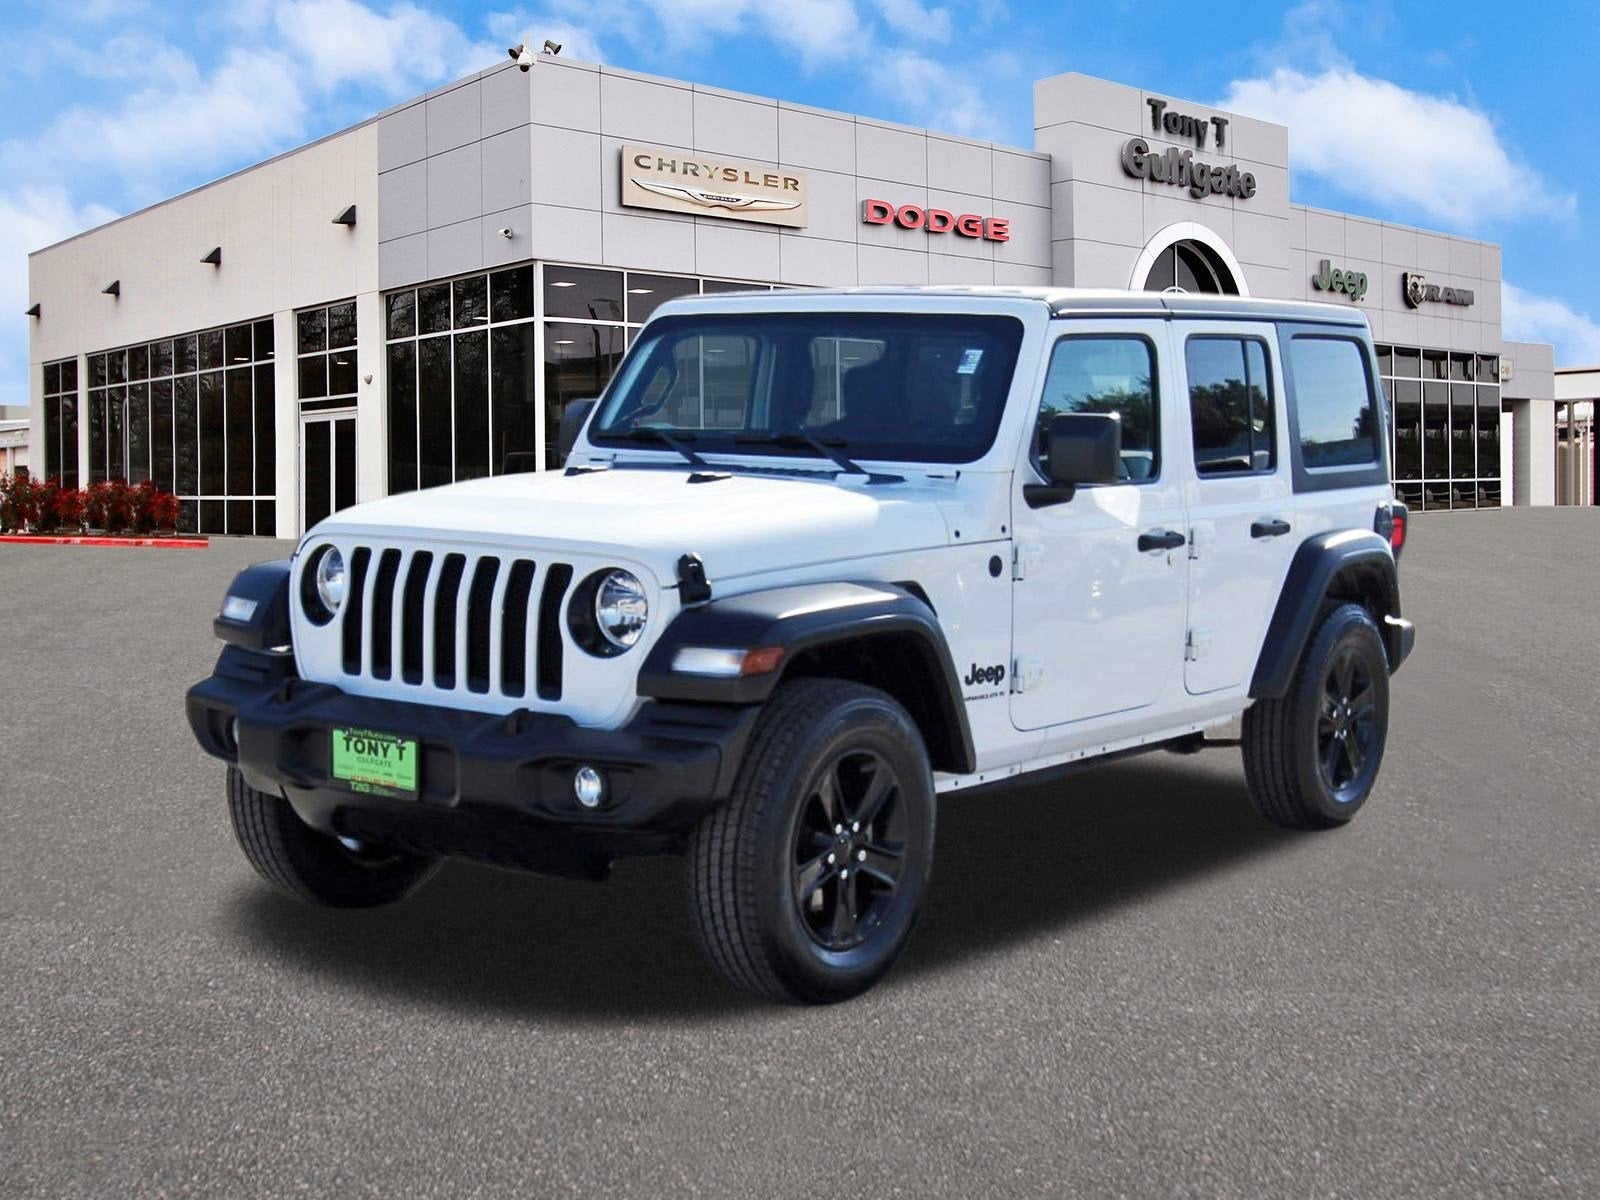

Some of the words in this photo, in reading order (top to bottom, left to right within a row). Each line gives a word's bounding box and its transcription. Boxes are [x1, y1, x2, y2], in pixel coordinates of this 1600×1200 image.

[1146, 98, 1209, 148] Tony
[1210, 116, 1229, 147] T
[633, 154, 801, 192] CHRYSLER
[1121, 137, 1257, 199] Gulfgate
[862, 199, 1011, 242] DODGE
[1313, 259, 1368, 301] Jeep
[1425, 284, 1475, 306] RAM
[964, 662, 1005, 686] Jeep
[343, 736, 390, 759] TONY
[396, 744, 406, 761] T
